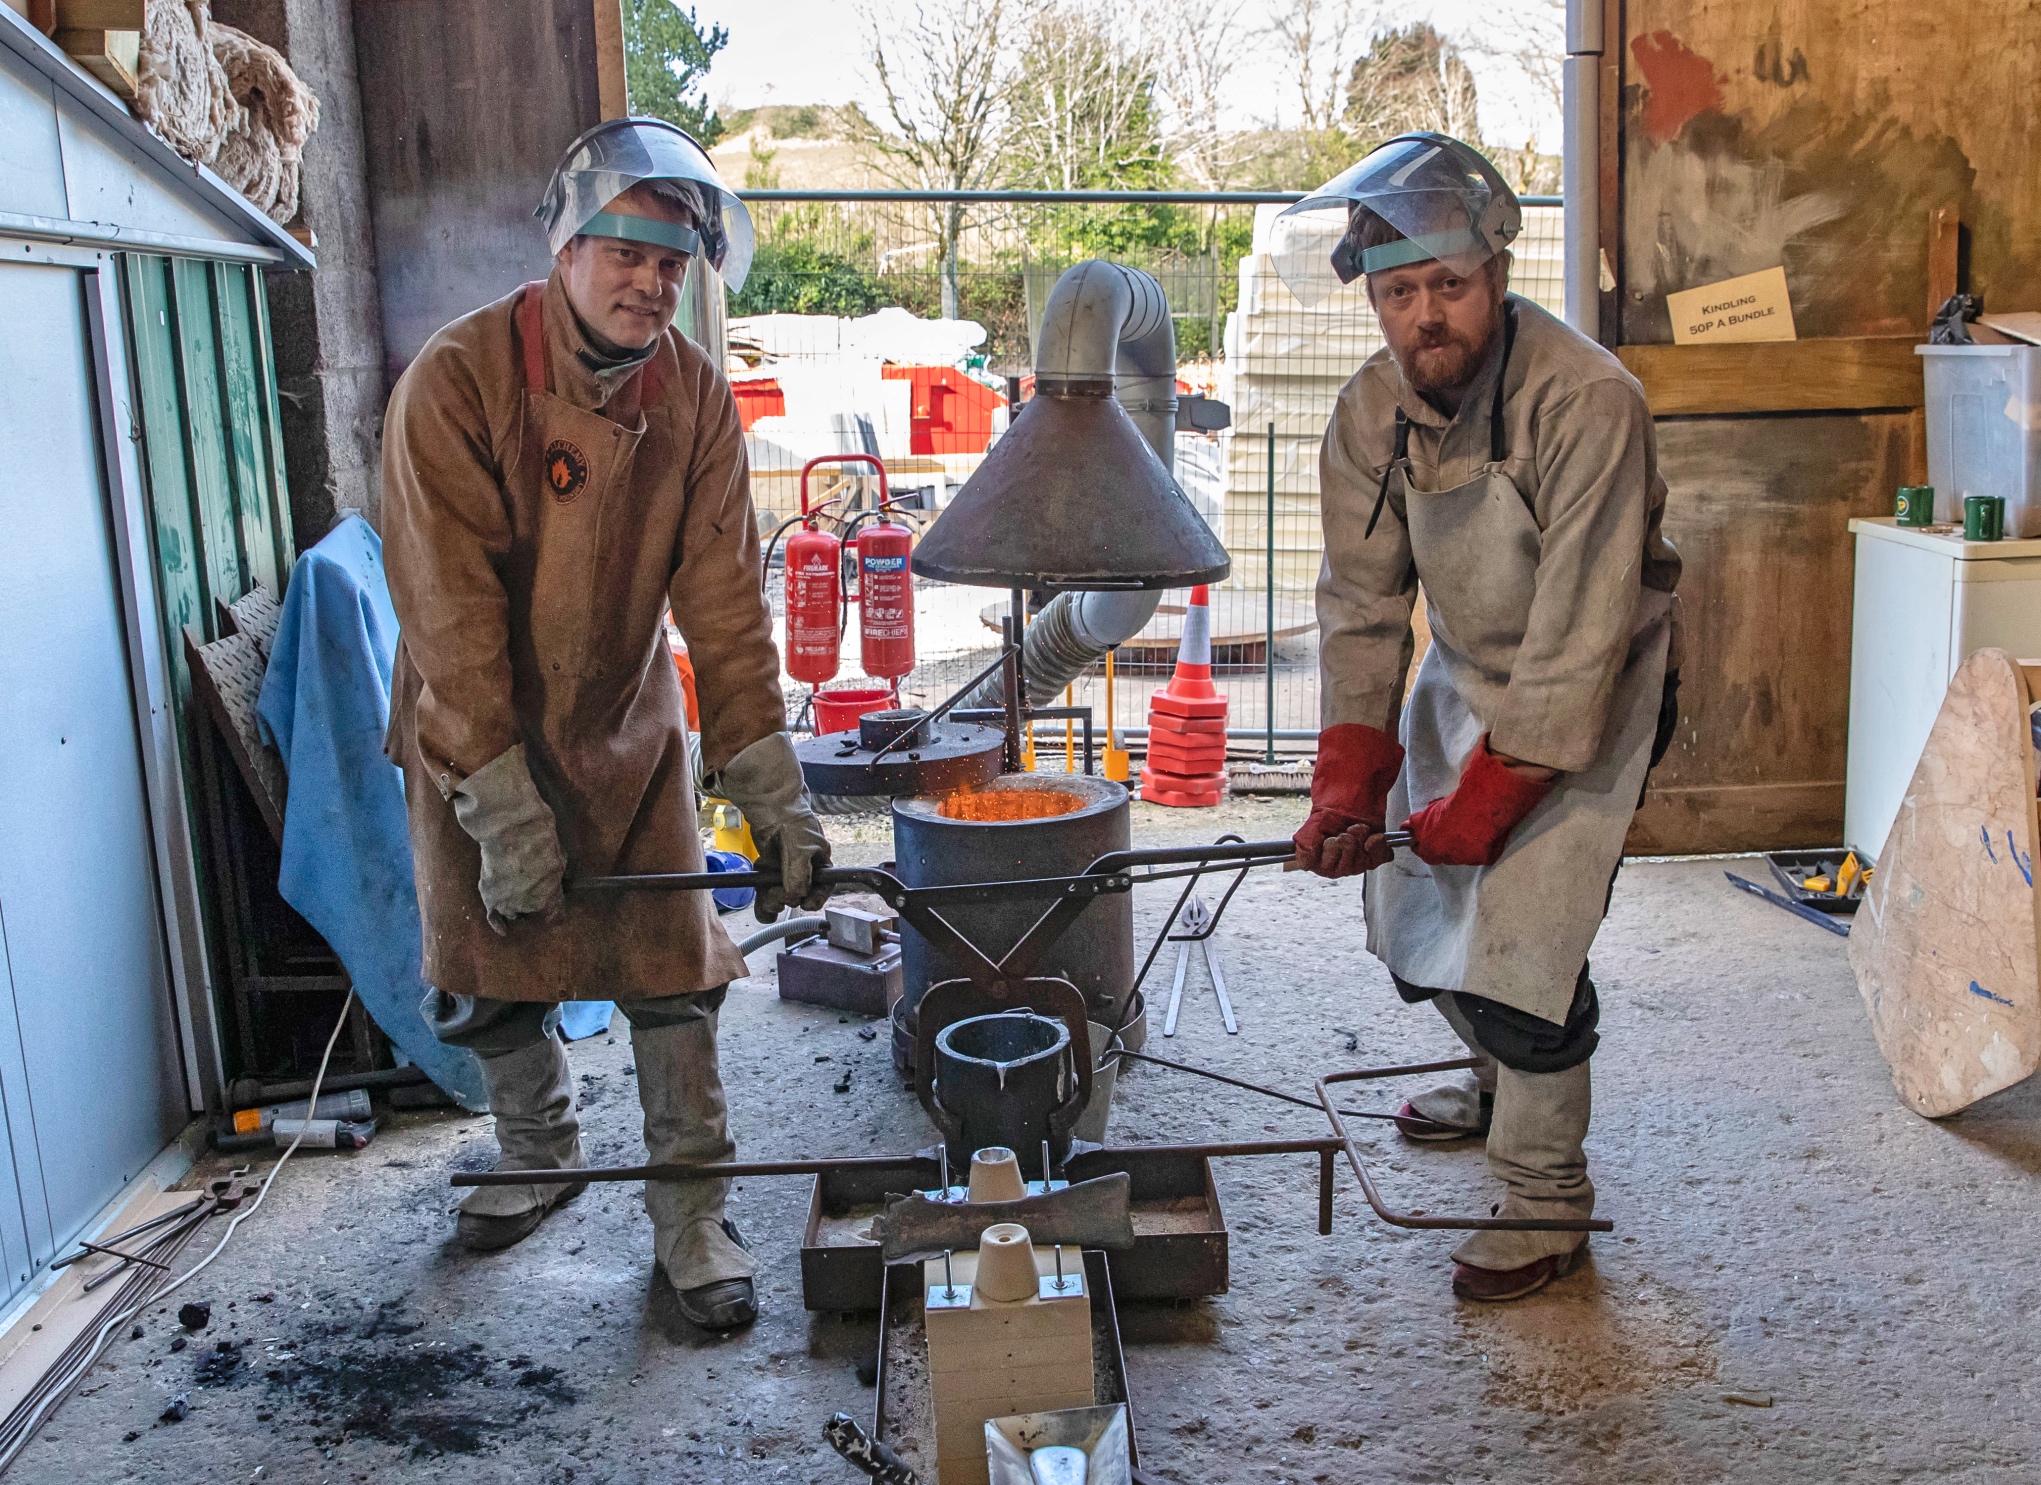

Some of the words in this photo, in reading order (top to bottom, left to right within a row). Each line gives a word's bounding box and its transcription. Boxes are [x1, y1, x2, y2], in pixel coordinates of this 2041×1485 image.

[1717, 319, 1726, 329] A
[1728, 307, 1775, 325] BUNDLE
[865, 557, 903, 566] POWDER
